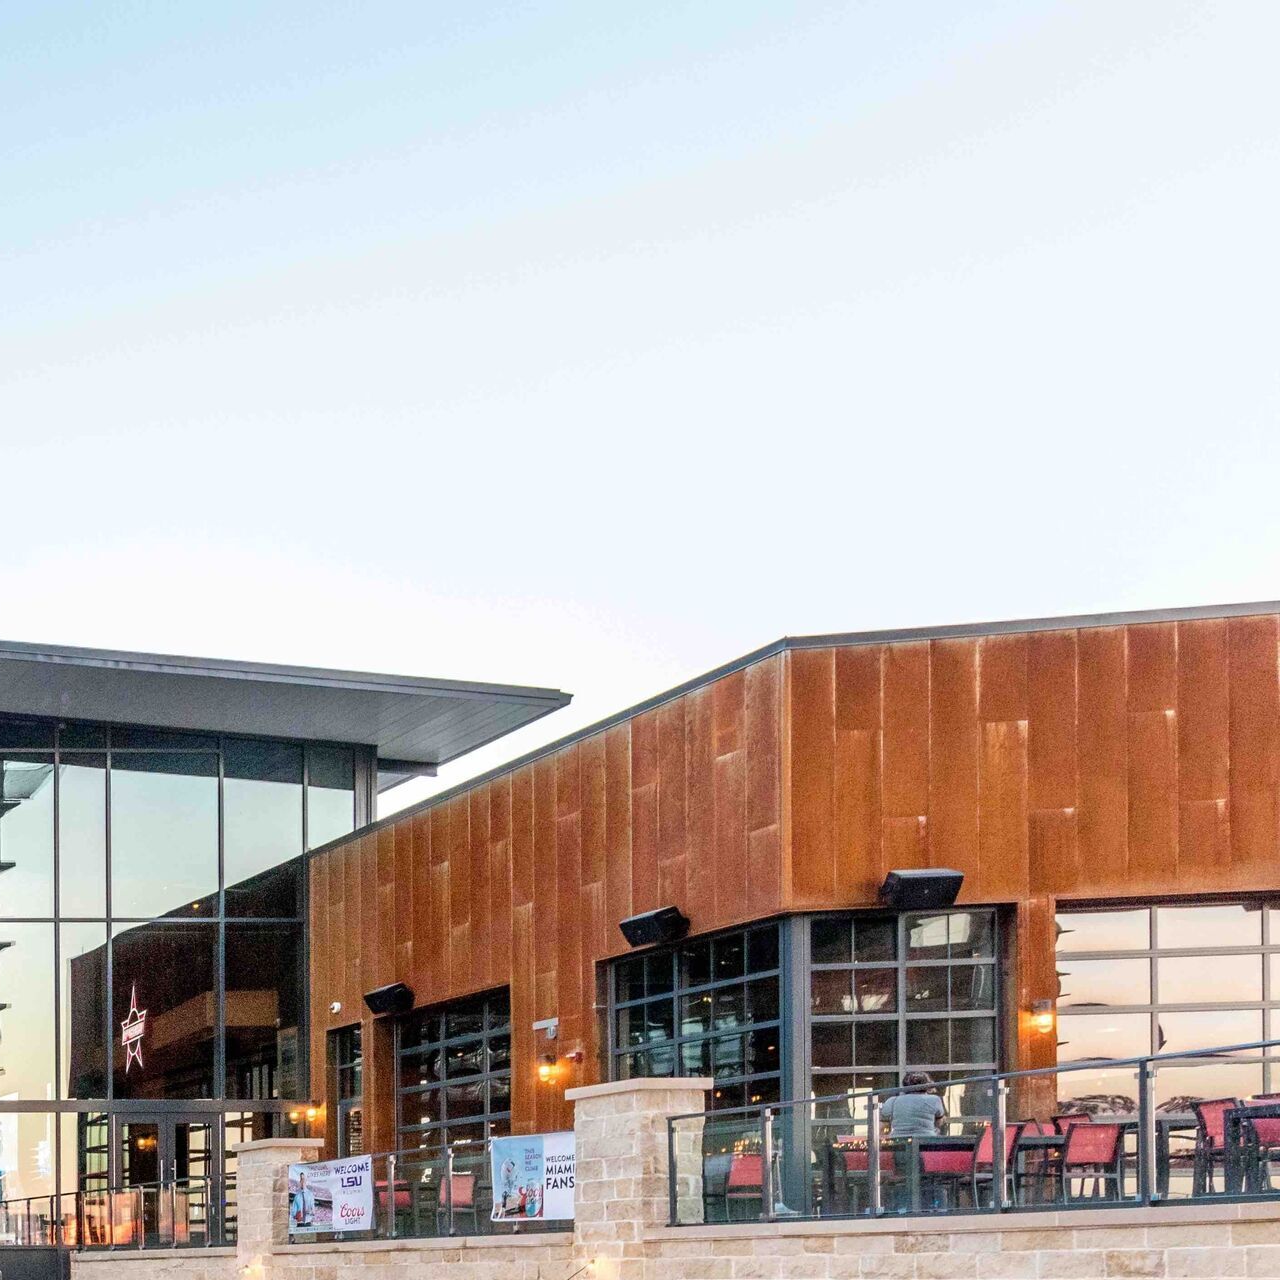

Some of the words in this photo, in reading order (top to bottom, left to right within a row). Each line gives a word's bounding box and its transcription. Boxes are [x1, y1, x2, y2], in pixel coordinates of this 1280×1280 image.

[545, 1154, 575, 1163] WELCOME
[334, 1162, 370, 1175] WELCOME
[545, 1164, 575, 1175] MIAMI
[341, 1175, 362, 1188] LSU
[545, 1176, 575, 1190] FANS
[340, 1203, 365, 1218] Coors
[345, 1217, 361, 1225] LIGHT
